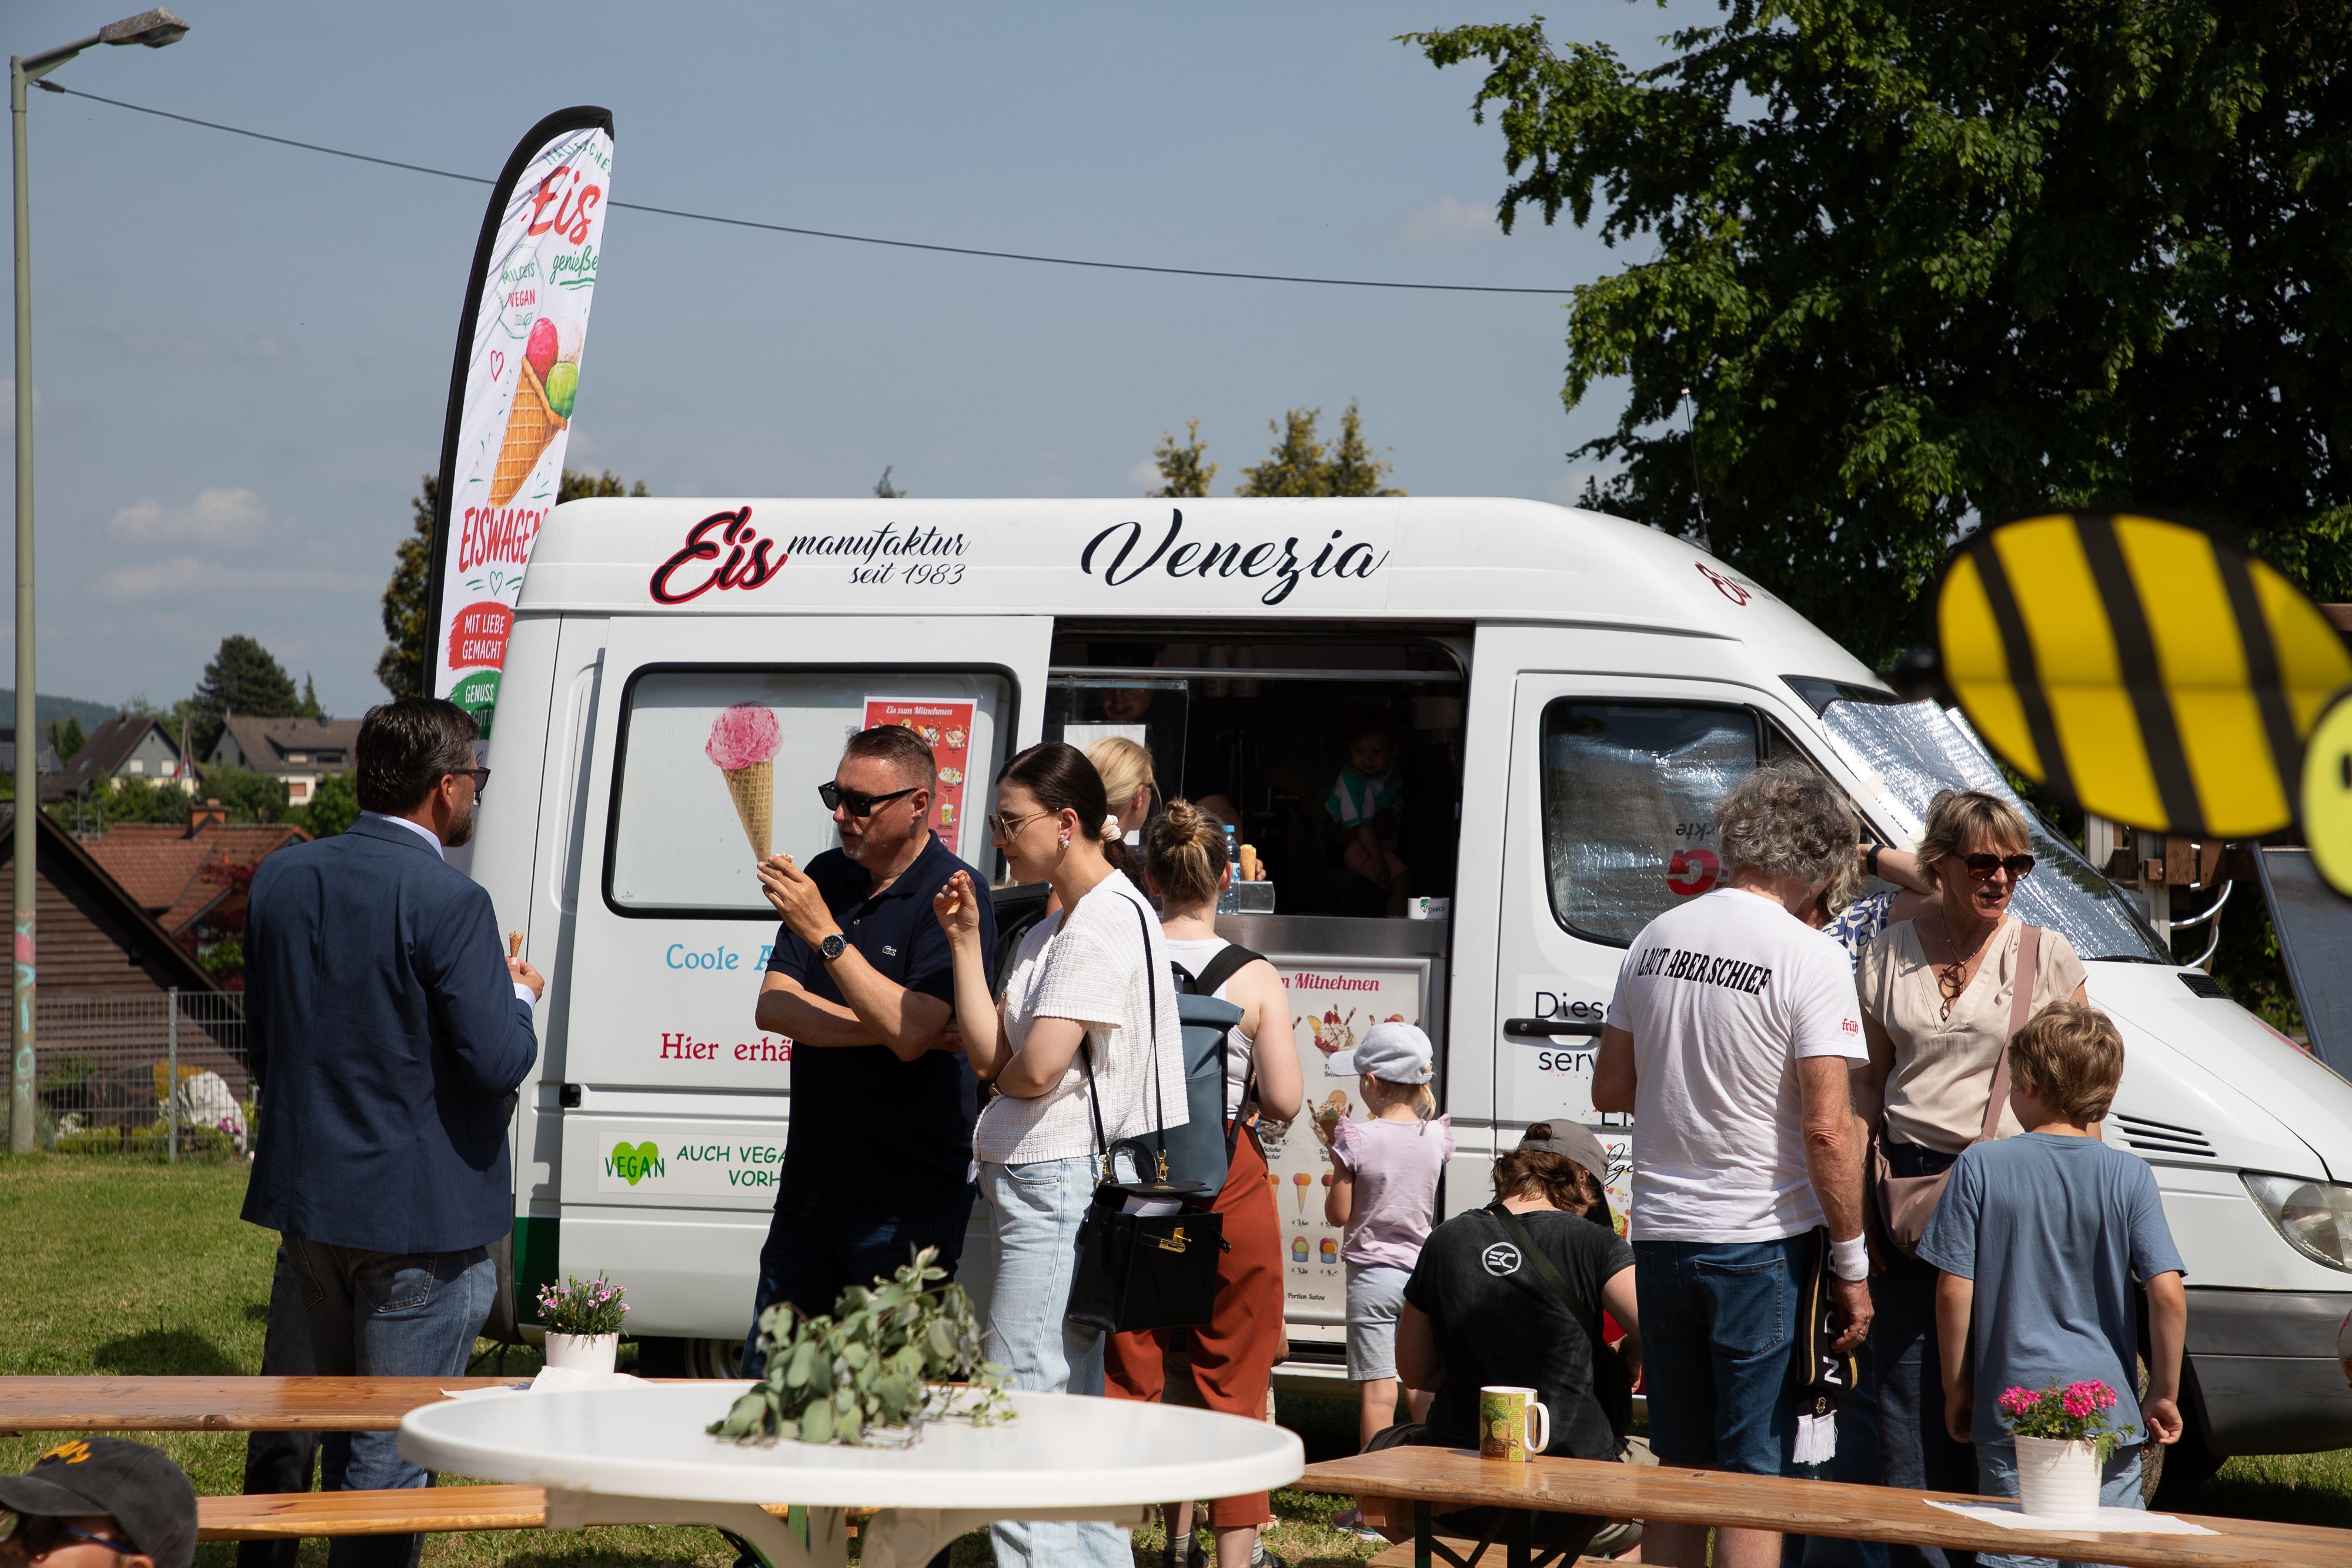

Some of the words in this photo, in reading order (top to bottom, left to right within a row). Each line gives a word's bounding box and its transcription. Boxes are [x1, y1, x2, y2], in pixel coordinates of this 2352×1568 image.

[527, 166, 601, 246] Eis
[509, 289, 535, 307] VEGAN
[649, 506, 788, 605] Eis
[786, 521, 971, 565] manufaktur
[1081, 508, 1390, 606] Venezia
[848, 561, 895, 585] seit
[901, 562, 966, 585] 1983
[465, 614, 481, 634] MIT
[482, 614, 506, 634] LIEBE
[462, 639, 502, 660] GEMACHT
[886, 706, 896, 714] Eis
[914, 706, 953, 716] Mitnehmen
[666, 943, 739, 970] Coole
[1295, 973, 1379, 991] Mitnehmen
[1663, 949, 1710, 983] ABER
[1705, 957, 1773, 995] SCHIEF
[1842, 1018, 1859, 1034] früh
[660, 1033, 719, 1059] Hier
[676, 1145, 730, 1162] AUCH
[605, 1155, 665, 1179] VEGAN
